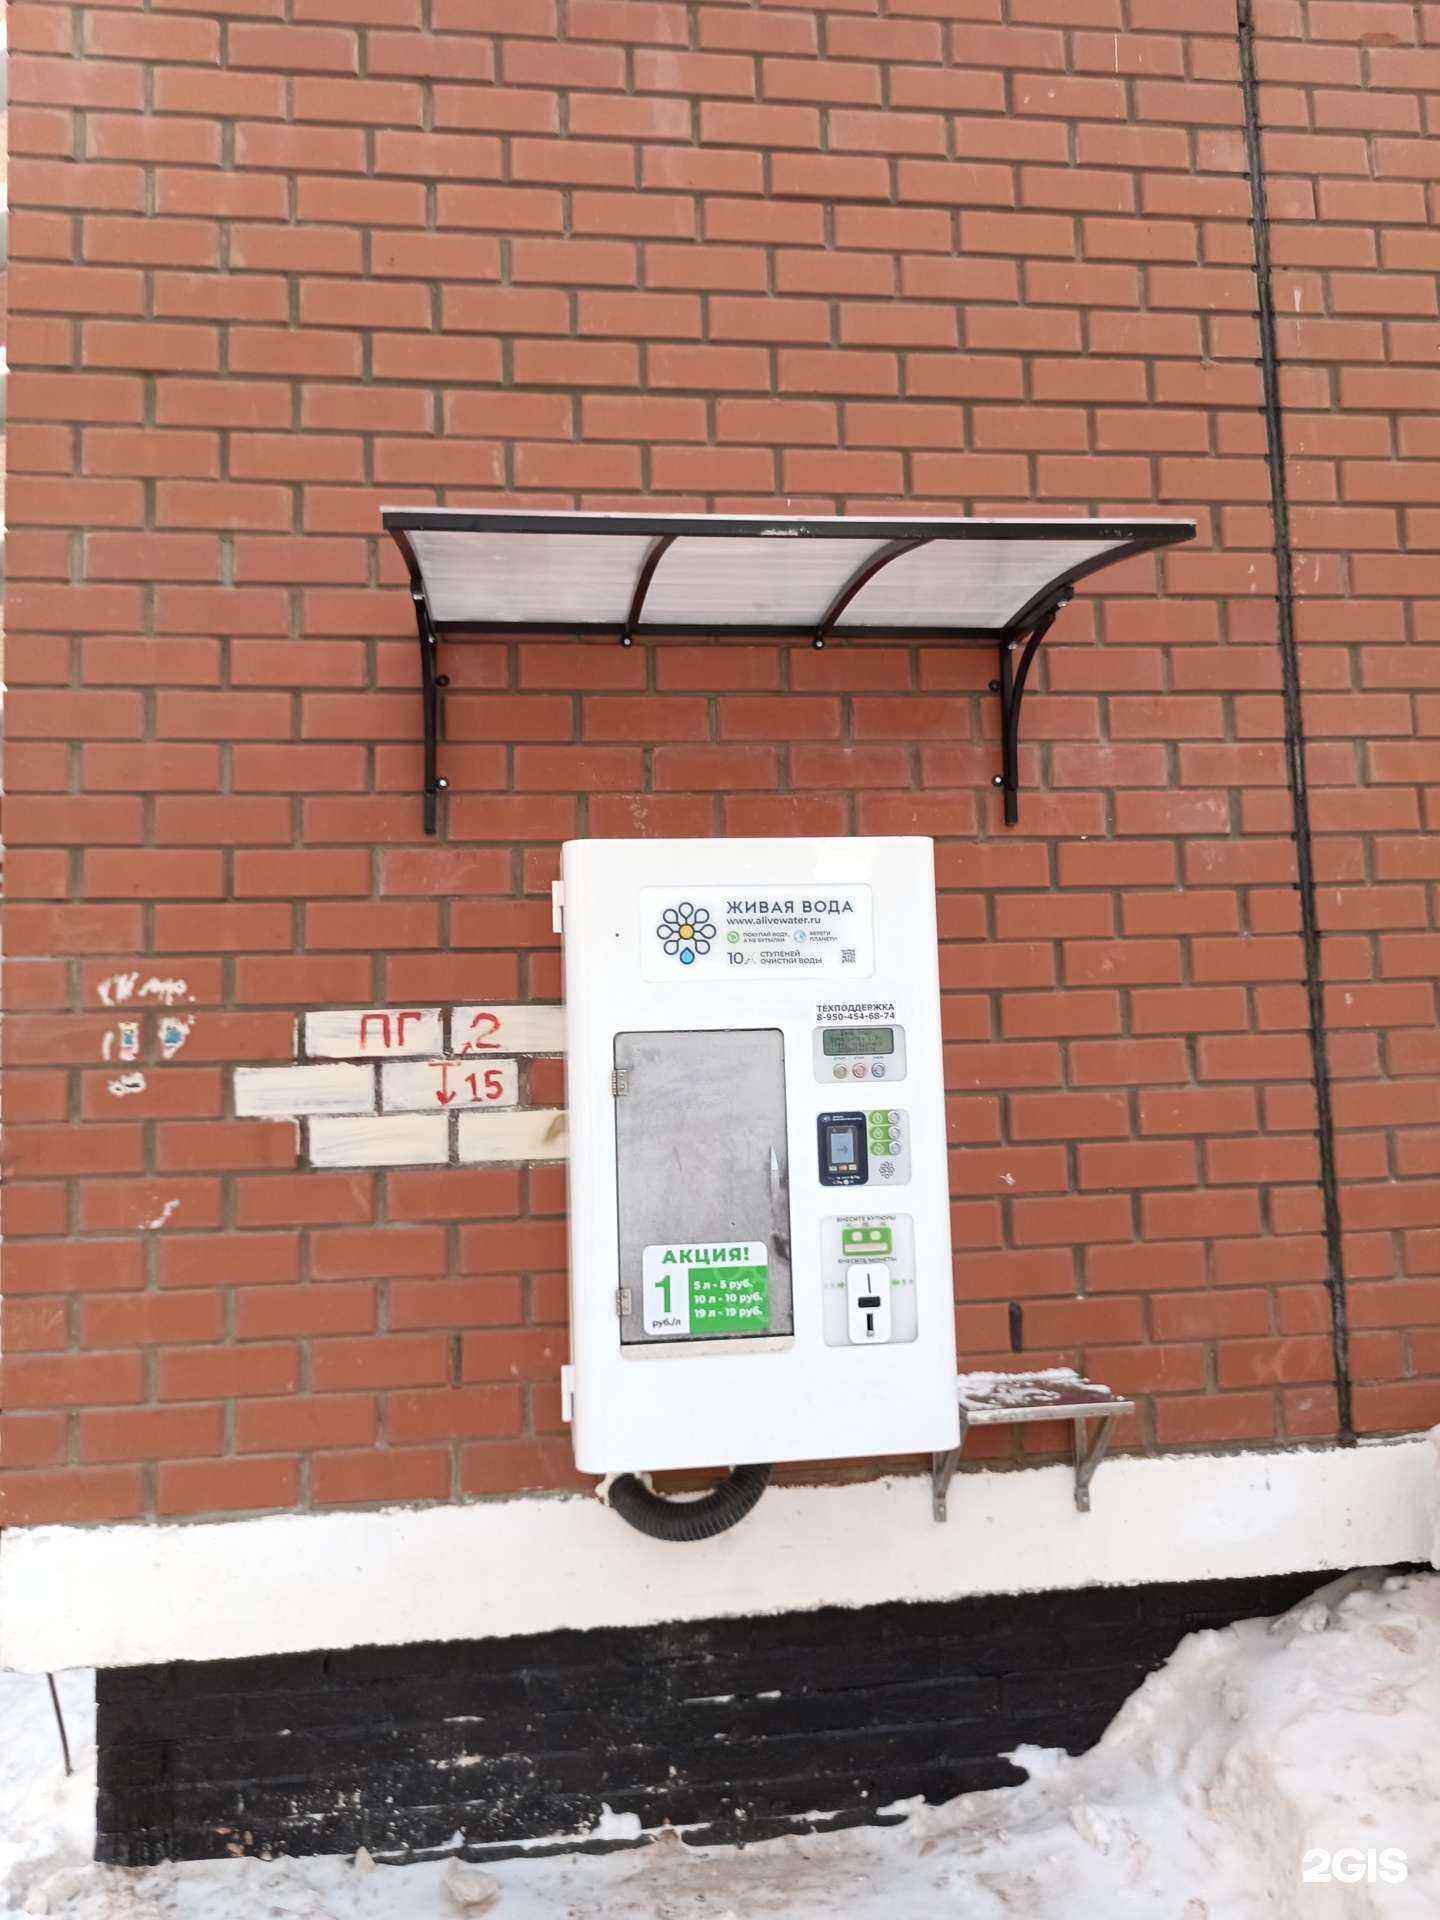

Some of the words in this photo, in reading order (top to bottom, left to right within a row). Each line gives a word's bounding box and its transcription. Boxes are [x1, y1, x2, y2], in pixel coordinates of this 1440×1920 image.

[726, 900, 794, 914] ЖИВАЯ
[802, 900, 854, 915] ВОДА
[726, 916, 821, 925] www.alivewater.ru
[760, 949, 801, 958] СТУПЕНЕЙ
[760, 957, 797, 965] ОЧИСТКИ
[798, 957, 823, 965] ВОДЫ
[816, 1003, 895, 1013] ТЕХПОДДЕРЖКА
[816, 1012, 895, 1021] 8-950-454-68-74
[360, 1011, 422, 1049] ПГ
[470, 1012, 502, 1049] 2
[465, 1069, 504, 1102] 15
[662, 1247, 749, 1265] АКЦИЯ!
[693, 1280, 701, 1290] 5
[702, 1281, 711, 1290] л
[719, 1280, 727, 1289] 5
[729, 1278, 753, 1290] руб.
[654, 1275, 671, 1313] 1
[694, 1295, 705, 1304] 10
[708, 1296, 716, 1304] л
[725, 1293, 737, 1302] 10
[739, 1291, 763, 1304] руб.
[707, 1309, 716, 1318] л
[739, 1306, 763, 1319] руб.
[652, 1317, 682, 1328] руб./л
